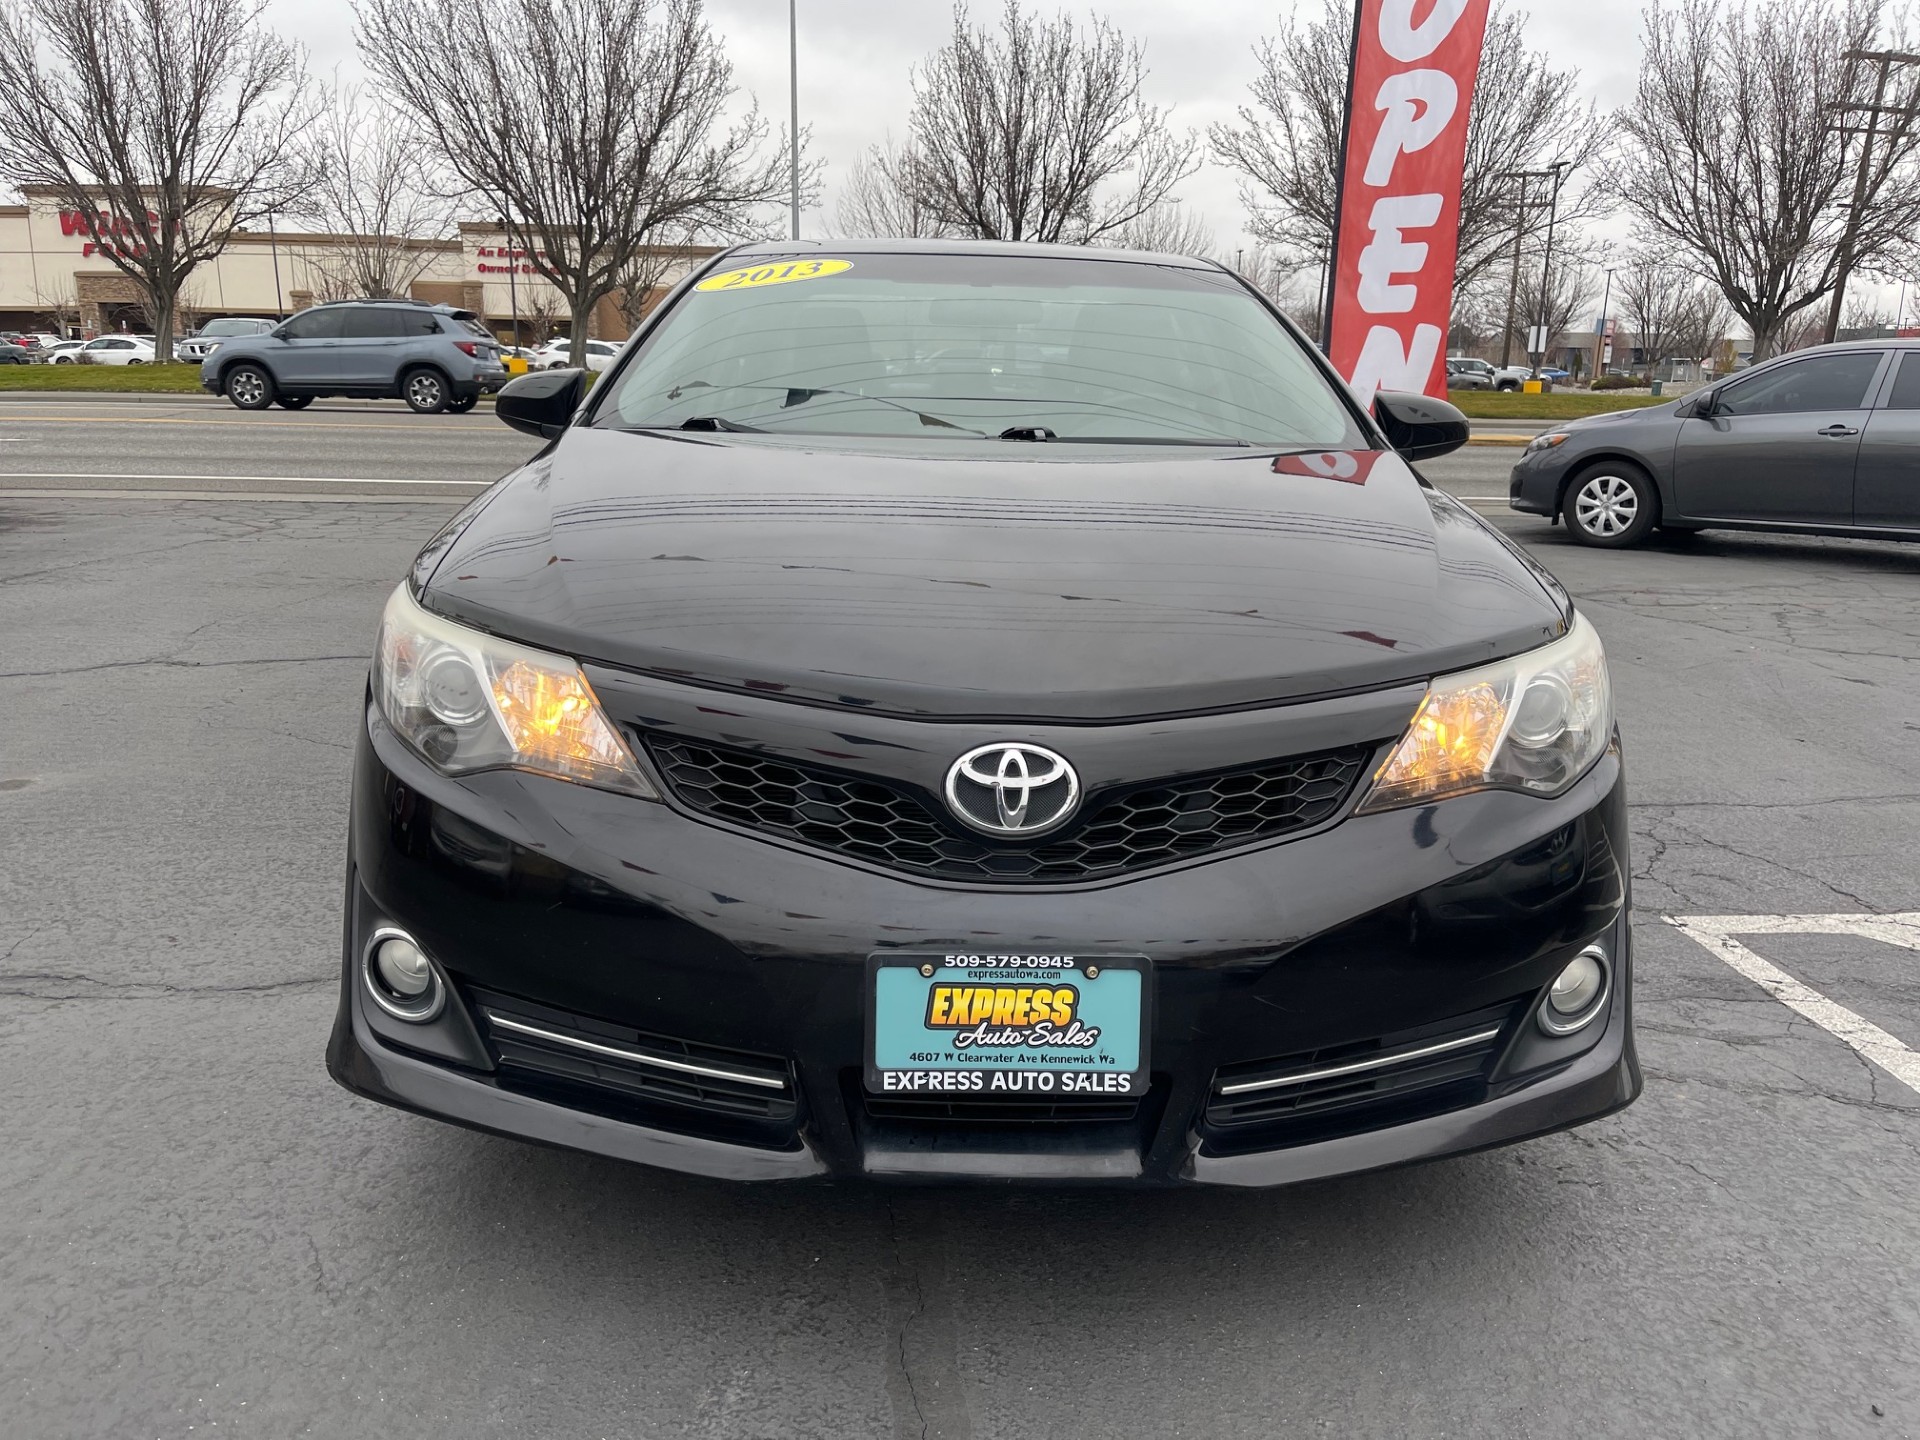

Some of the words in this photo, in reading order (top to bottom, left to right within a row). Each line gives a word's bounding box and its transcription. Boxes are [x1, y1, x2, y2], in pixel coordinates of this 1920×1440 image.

[1349, 0, 1468, 407] OPEN
[477, 247, 494, 257] An
[478, 264, 518, 273] Owned
[722, 262, 824, 287] 2013
[945, 955, 1074, 968] 509-579-0945
[967, 968, 1061, 981] expressautowa.com
[931, 988, 1074, 1026] EXPRESS
[955, 1023, 1024, 1047] Auto
[1027, 1022, 1098, 1047] Sales
[909, 1052, 940, 1062] 4607
[944, 1053, 954, 1062] W
[957, 1053, 1014, 1063] Clearwater
[1017, 1054, 1037, 1063] Ave
[1040, 1054, 1095, 1064] Kennewick
[1098, 1054, 1115, 1065] Wa
[883, 1071, 983, 1090] EXPRESS
[991, 1072, 1054, 1091] AUTO
[1061, 1073, 1131, 1092] SALES
